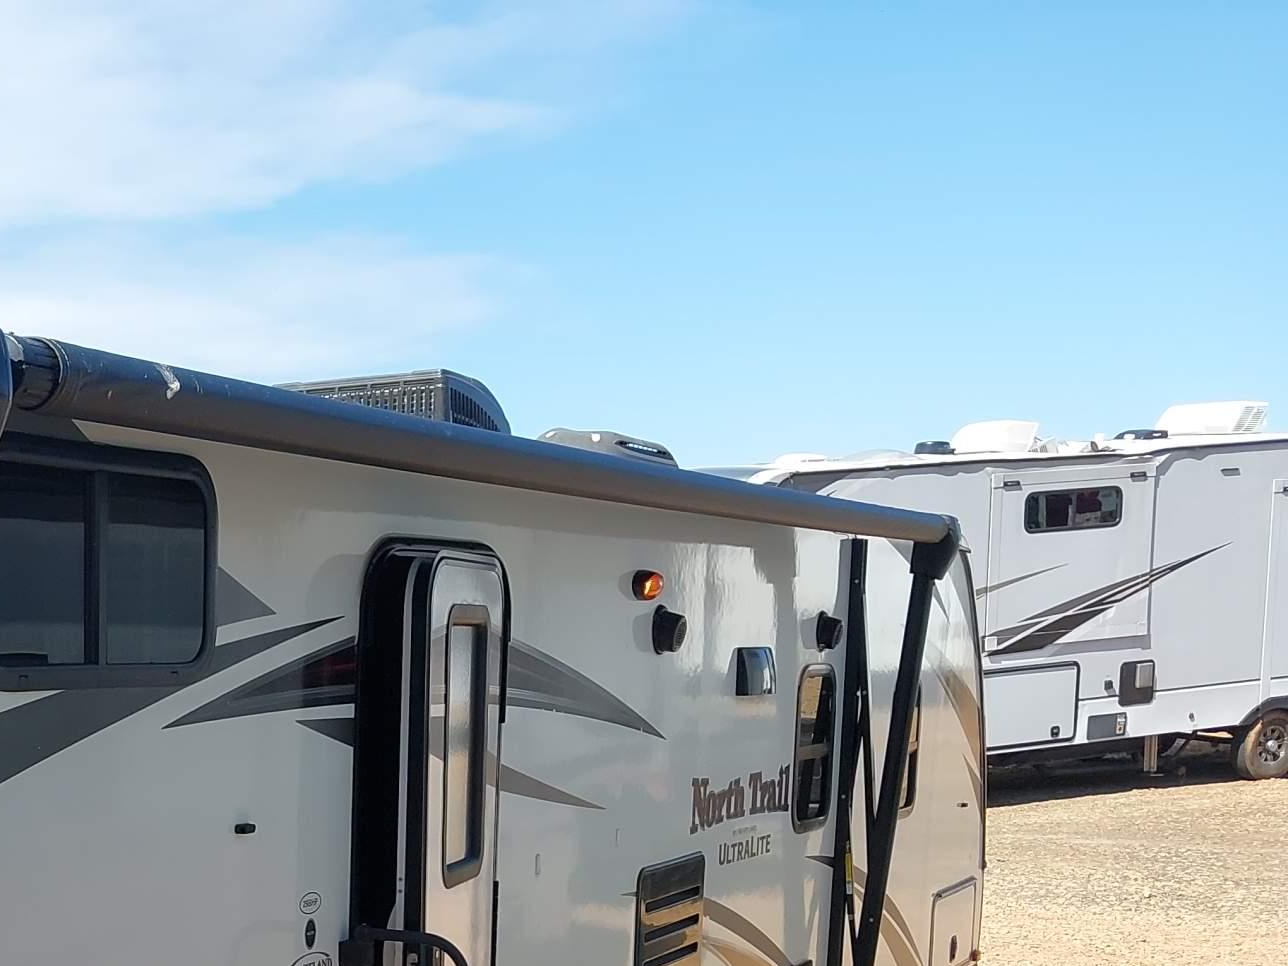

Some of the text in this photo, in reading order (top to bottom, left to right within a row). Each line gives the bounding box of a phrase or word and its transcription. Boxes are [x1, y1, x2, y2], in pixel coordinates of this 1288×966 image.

[689, 763, 791, 836] North Trail
[718, 833, 772, 866] ULTRALITE
